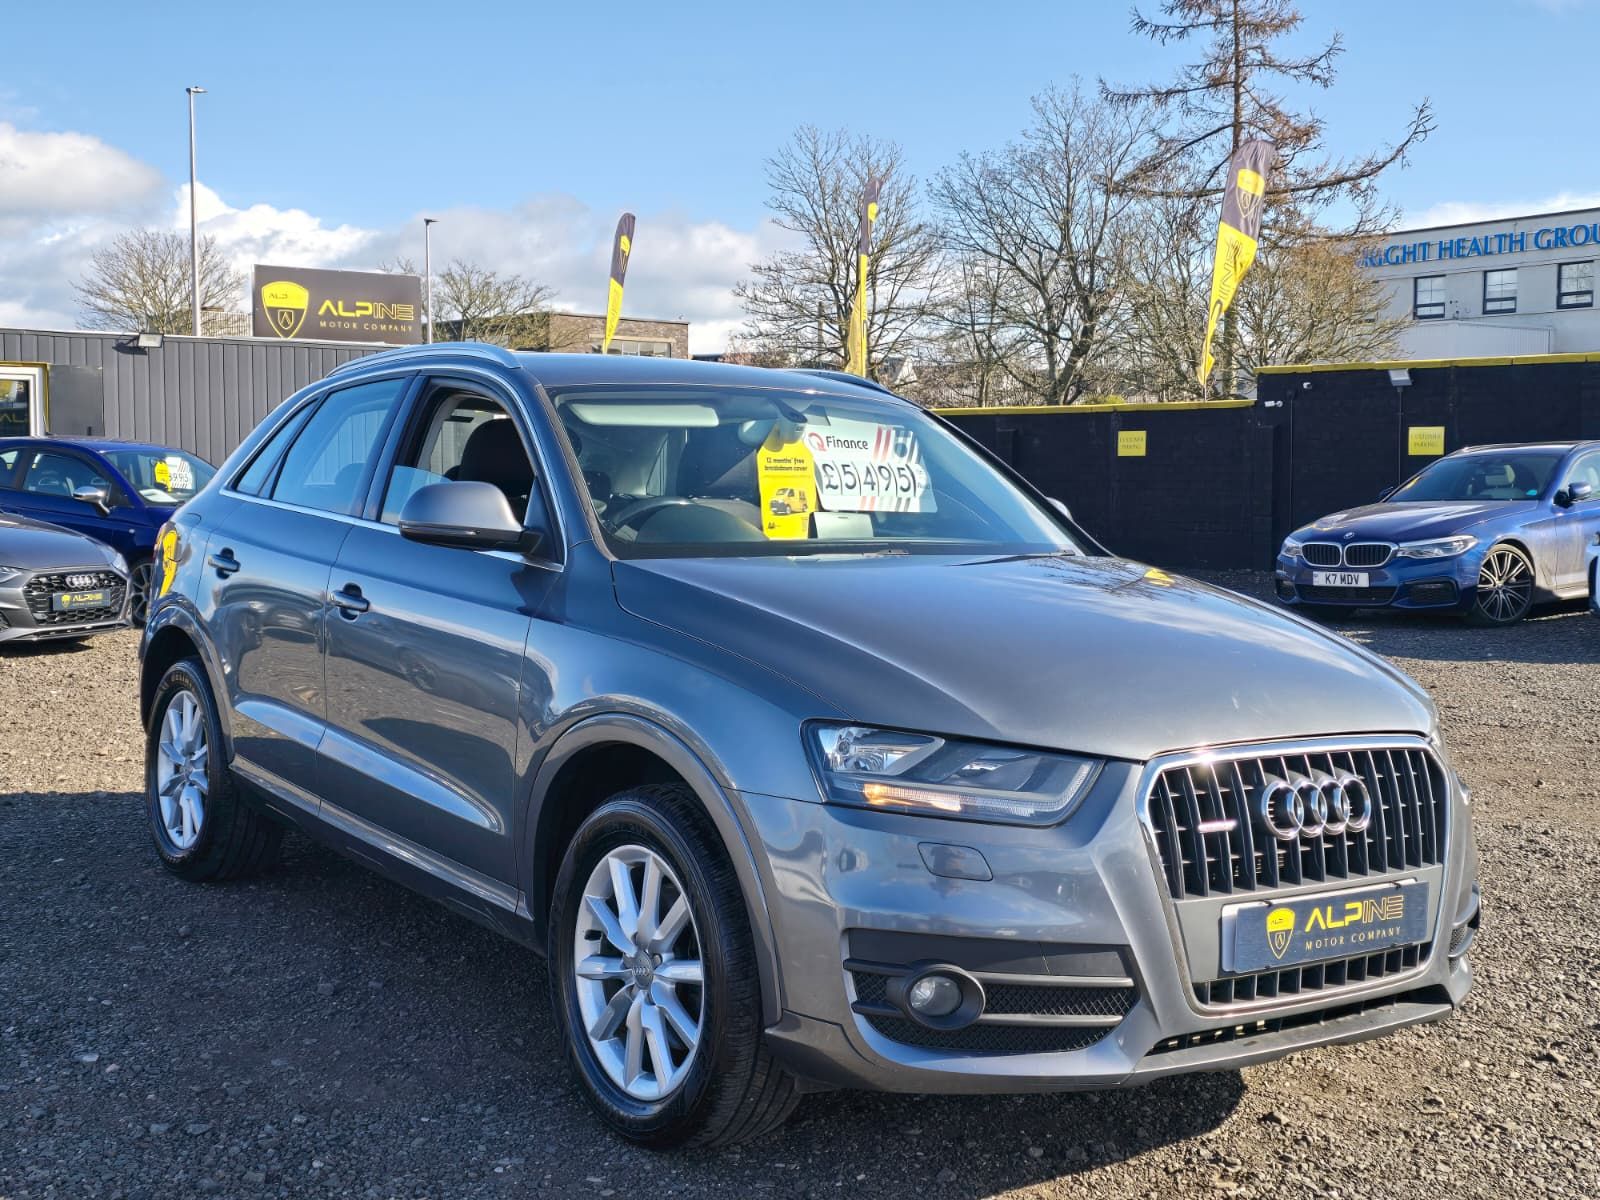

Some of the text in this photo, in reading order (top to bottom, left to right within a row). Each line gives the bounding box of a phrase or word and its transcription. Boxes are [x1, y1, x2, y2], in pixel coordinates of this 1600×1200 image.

[1356, 240, 1430, 268] RIGHT
[1438, 231, 1527, 260] HEALTH
[318, 299, 414, 321] ALPINE
[319, 320, 413, 332] MOTOR COMPANY
[826, 435, 869, 450] Finance
[822, 463, 911, 493] £5495
[1325, 573, 1360, 585] K7 MDV
[1305, 895, 1404, 932] ALPINE
[1305, 926, 1401, 951] MOTOR COMPANY
